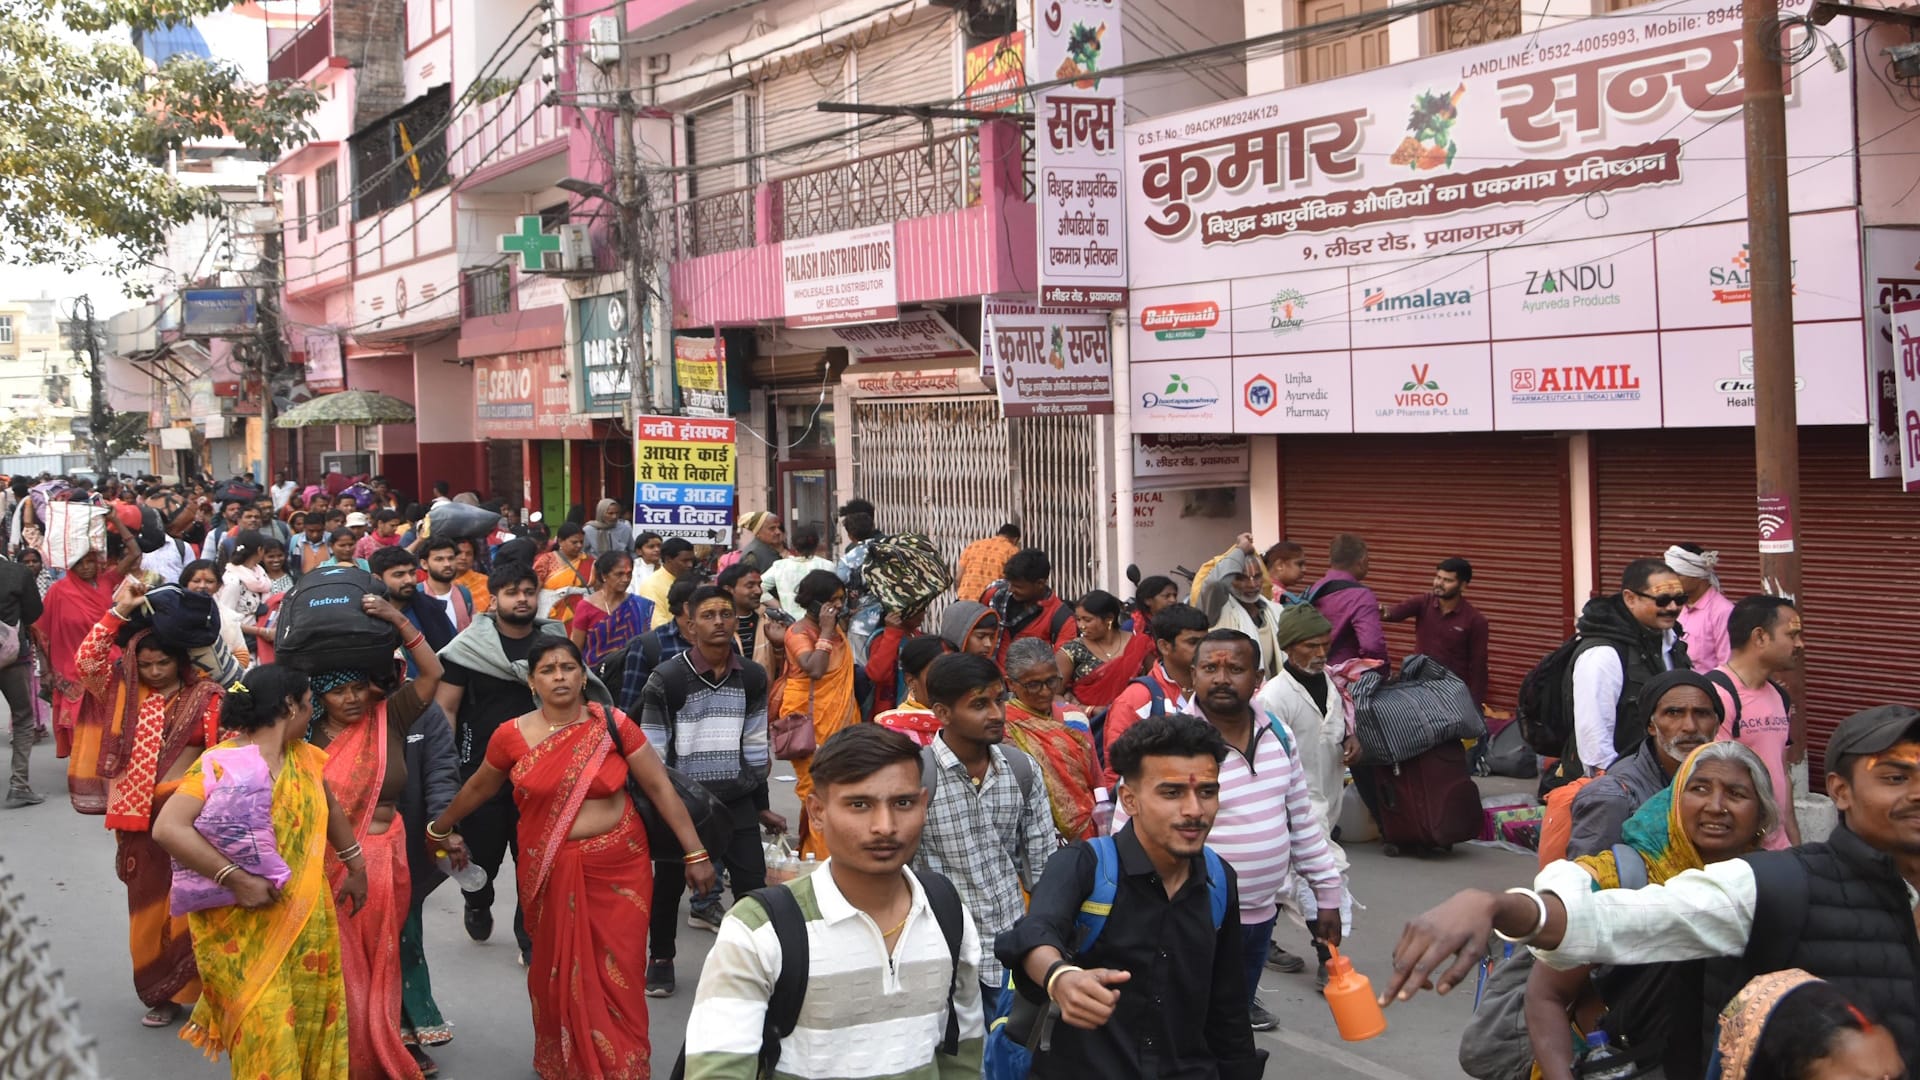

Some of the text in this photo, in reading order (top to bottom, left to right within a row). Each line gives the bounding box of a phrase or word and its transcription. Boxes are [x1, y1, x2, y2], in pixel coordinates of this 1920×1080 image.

[1461, 51, 1534, 79] LANDLINE:
[1538, 28, 1640, 62] 0532-4005993,
[1645, 17, 1701, 39] Mobile:
[1046, 96, 1116, 150] सन्स
[1139, 108, 1368, 236] कुमार
[1207, 212, 1257, 239] विशुद्ध
[1261, 200, 1348, 231] आयुर्वेदिक
[1436, 183, 1468, 202] का
[1471, 169, 1558, 197] एकमात्र
[1564, 152, 1668, 188] प्रतिष्ठान
[1096, 219, 1109, 236] का
[1325, 237, 1372, 259] लीडर
[1378, 231, 1416, 251] रोड,
[1424, 219, 1525, 248] प्रयागराज
[785, 240, 891, 282] PALASH DISTRIBUTORS
[1525, 263, 1614, 295] ZANDU
[794, 285, 834, 299] WHOLESALER
[841, 279, 884, 294] DISTRIBUTOR
[816, 296, 859, 309] OF MEDICINES
[1363, 287, 1471, 312] Himalaya
[1522, 294, 1620, 313] Ayurveda Products
[1145, 306, 1215, 327] Baidyanath
[1271, 316, 1303, 329] Dabur
[995, 326, 1108, 388] कुमार सन्स
[489, 368, 531, 401] SERVO
[1285, 372, 1312, 387] Unjha
[1538, 364, 1640, 392] AIMIL
[1285, 388, 1328, 404] Ayurvedic
[1394, 392, 1448, 407] VIRGO
[1286, 406, 1330, 421] Pharmacy
[1375, 408, 1394, 417] UAP
[1396, 408, 1430, 416] Pharma
[643, 421, 675, 437] मनी
[696, 445, 729, 462] कार्ड
[640, 462, 730, 482] से पैसे निकालें
[684, 487, 727, 503] आउट
[1111, 492, 1163, 503] SGICAL
[640, 504, 728, 524] रेल टिकट
[309, 596, 350, 608] fastrack
[1740, 717, 1763, 728] ACK
